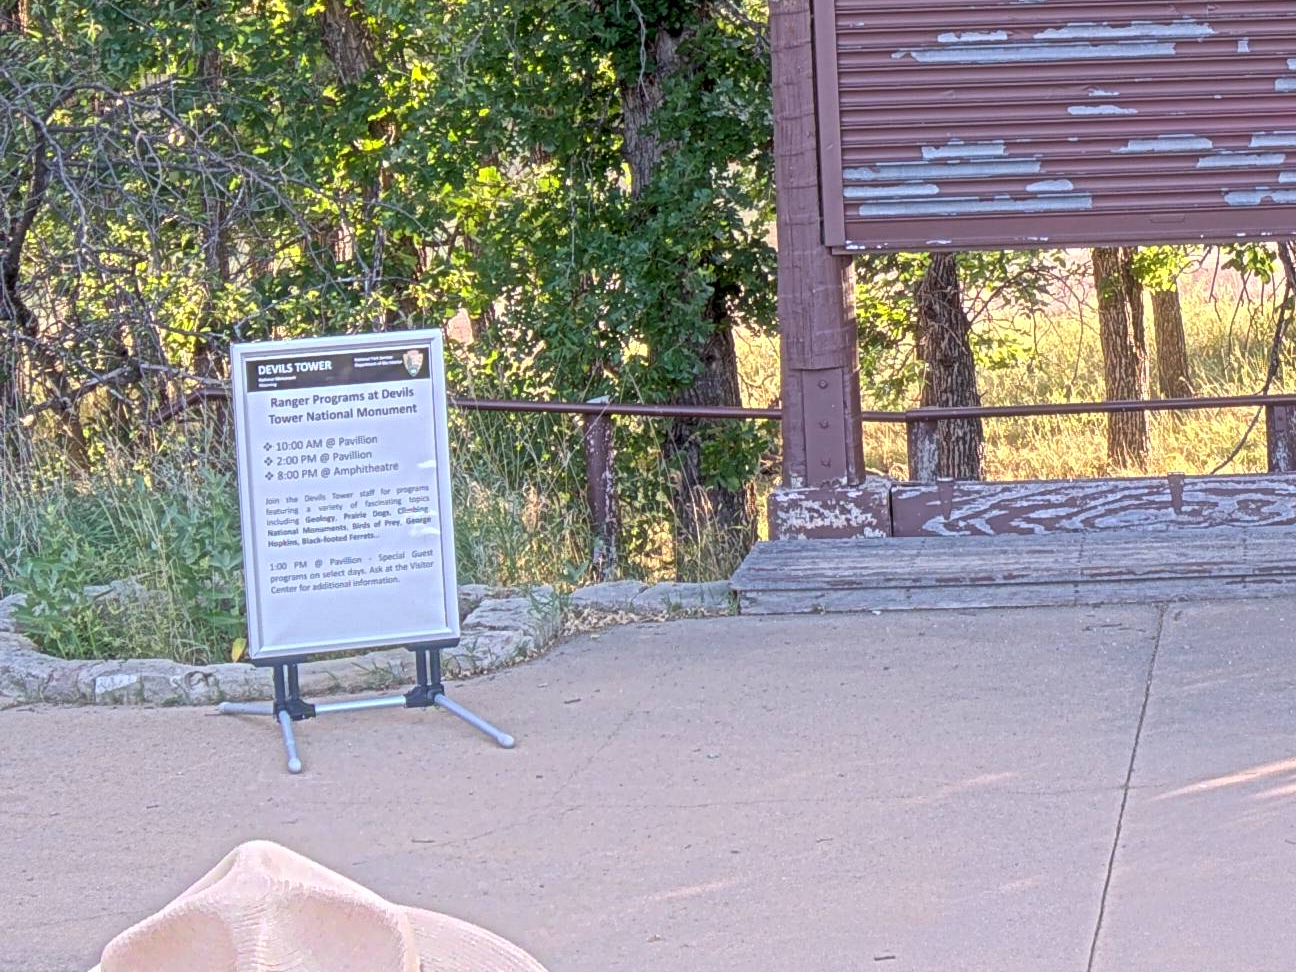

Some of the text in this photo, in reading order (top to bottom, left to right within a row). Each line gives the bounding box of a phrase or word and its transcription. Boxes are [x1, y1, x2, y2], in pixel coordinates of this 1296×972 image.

[257, 360, 332, 375] DEVILS TOWER
[270, 387, 414, 409] Ranger Programs at Devils
[268, 403, 417, 425] Tower National Monument
[276, 440, 304, 451] 10:00
[306, 439, 322, 449] AM
[326, 437, 336, 448] @
[276, 455, 298, 466] 2:00
[301, 454, 317, 464] PM
[320, 453, 330, 463] @
[277, 462, 399, 480] 8:00 PM @ Amphitheatre
[265, 497, 280, 505] Join
[304, 493, 326, 502] Devils
[332, 492, 353, 500] Tower
[396, 485, 429, 495] programs
[350, 501, 358, 509] of
[267, 527, 299, 537] National
[352, 521, 371, 530] Birds
[374, 520, 381, 528] of
[406, 517, 432, 525] George
[270, 562, 287, 571] 1:00
[294, 560, 307, 568] PM
[314, 559, 323, 568] @
[378, 551, 405, 562] Special
[411, 549, 433, 558] Guest
[270, 573, 307, 584] programs
[309, 572, 320, 580] on
[322, 569, 345, 578] select
[369, 565, 383, 574] Ask
[385, 565, 393, 573] at
[395, 563, 408, 571] the
[410, 561, 434, 570] Visitor
[271, 586, 297, 594] Center
[299, 583, 311, 592] for
